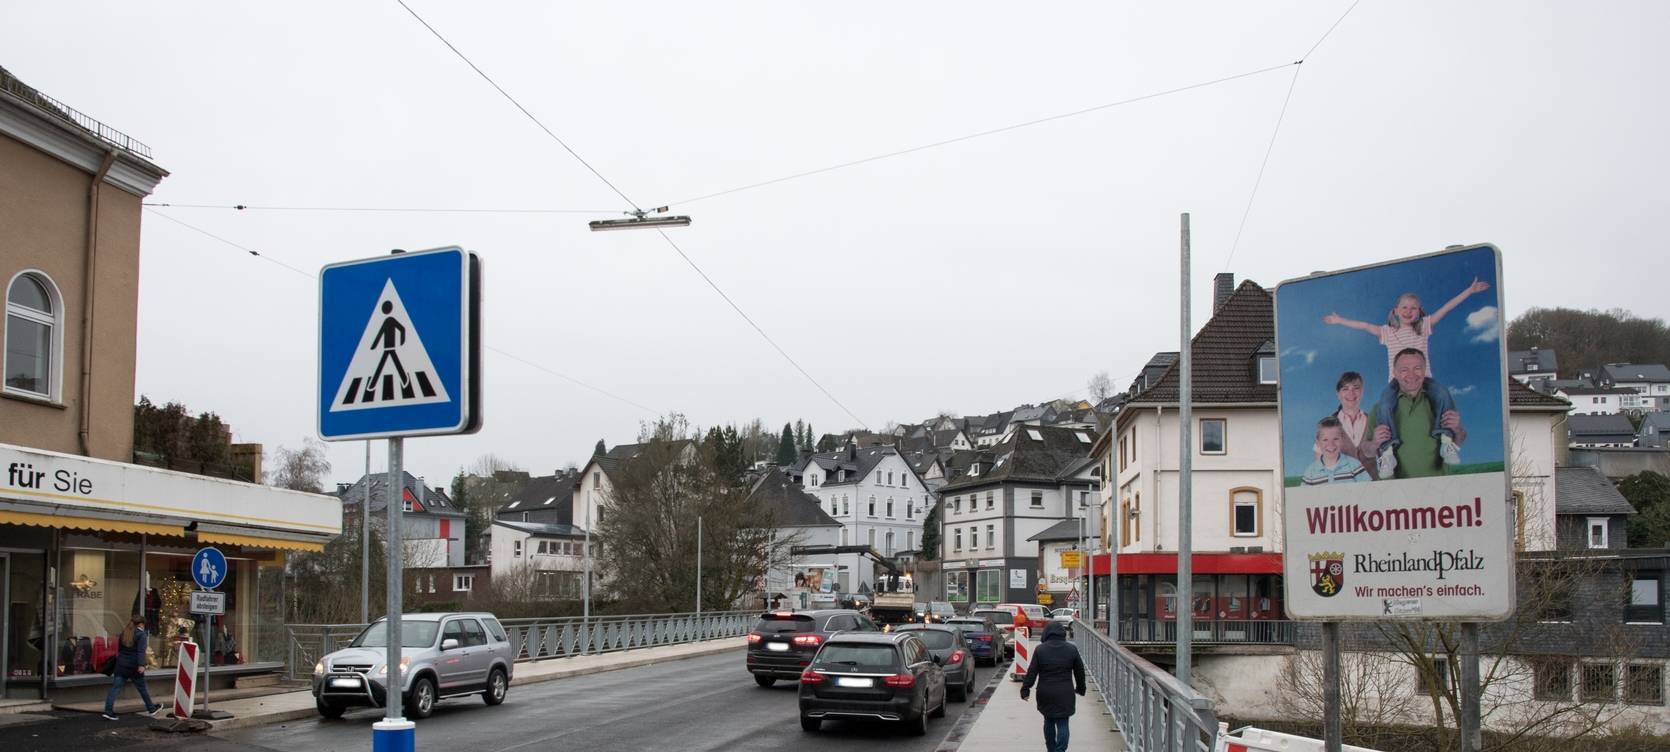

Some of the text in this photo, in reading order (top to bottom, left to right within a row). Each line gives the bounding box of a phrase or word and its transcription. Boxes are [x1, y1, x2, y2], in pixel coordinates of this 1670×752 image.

[9, 463, 93, 494] für Sie
[1306, 497, 1483, 534] Willkommen!
[1355, 584, 1485, 598] Wir machen's einfach.
